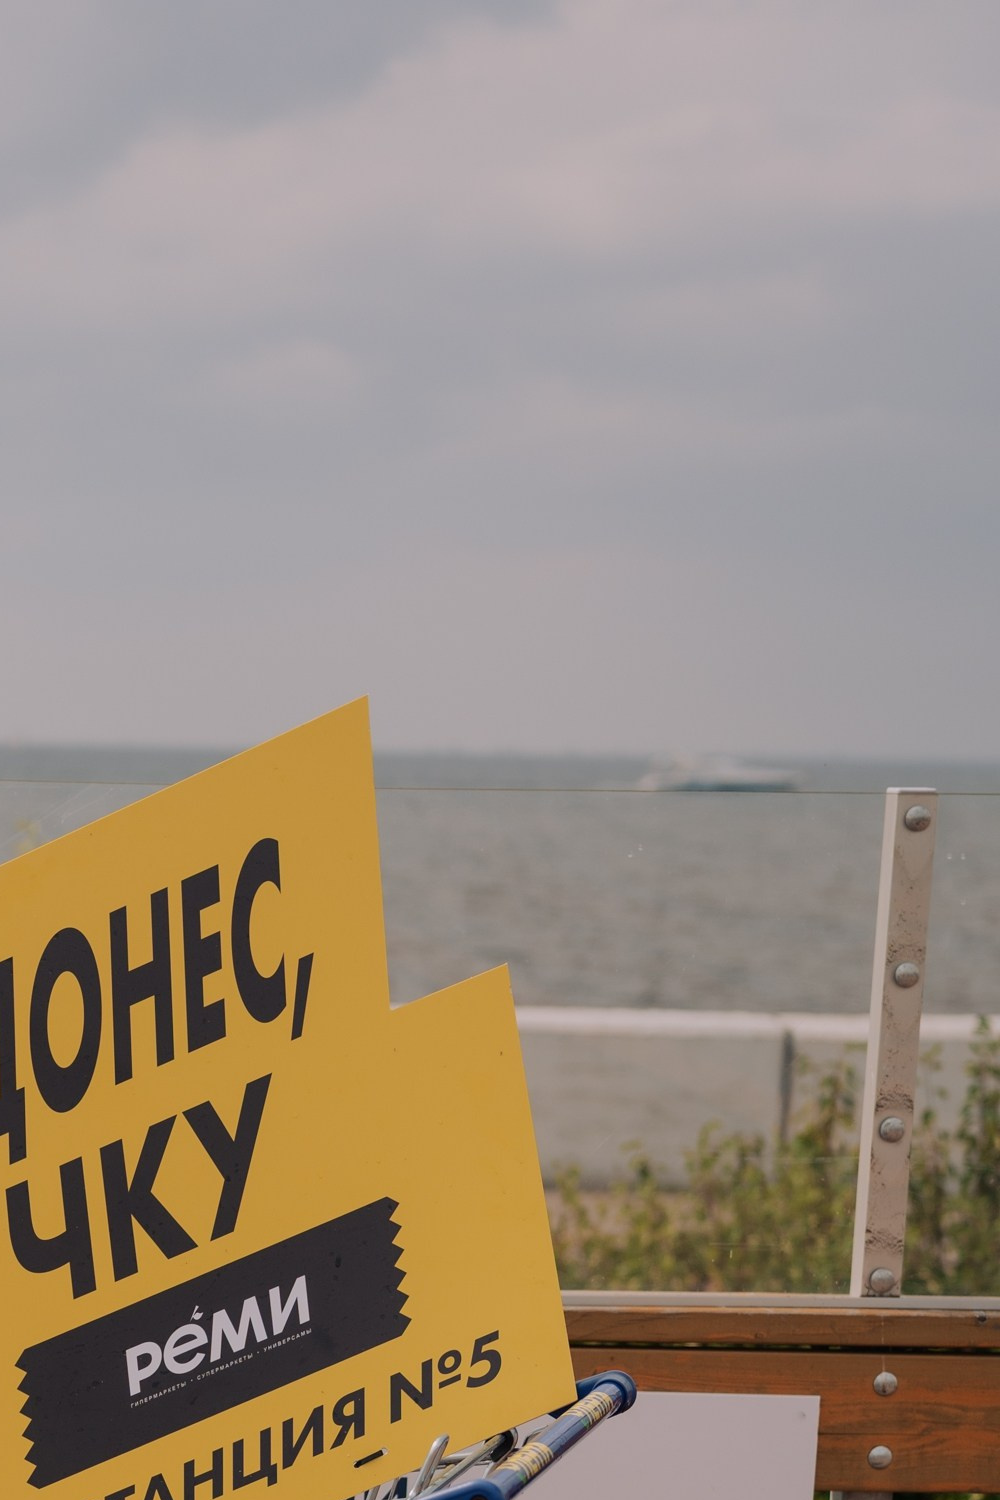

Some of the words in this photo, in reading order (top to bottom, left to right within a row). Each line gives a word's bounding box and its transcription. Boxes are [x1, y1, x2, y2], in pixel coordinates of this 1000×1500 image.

[130, 1381, 187, 1408] ГИПЕРМАРКЕТЫ
[196, 1353, 254, 1381] СУПЕРМАРКЕТЫ
[263, 1328, 312, 1352] УНИВЕРСАМЫ
